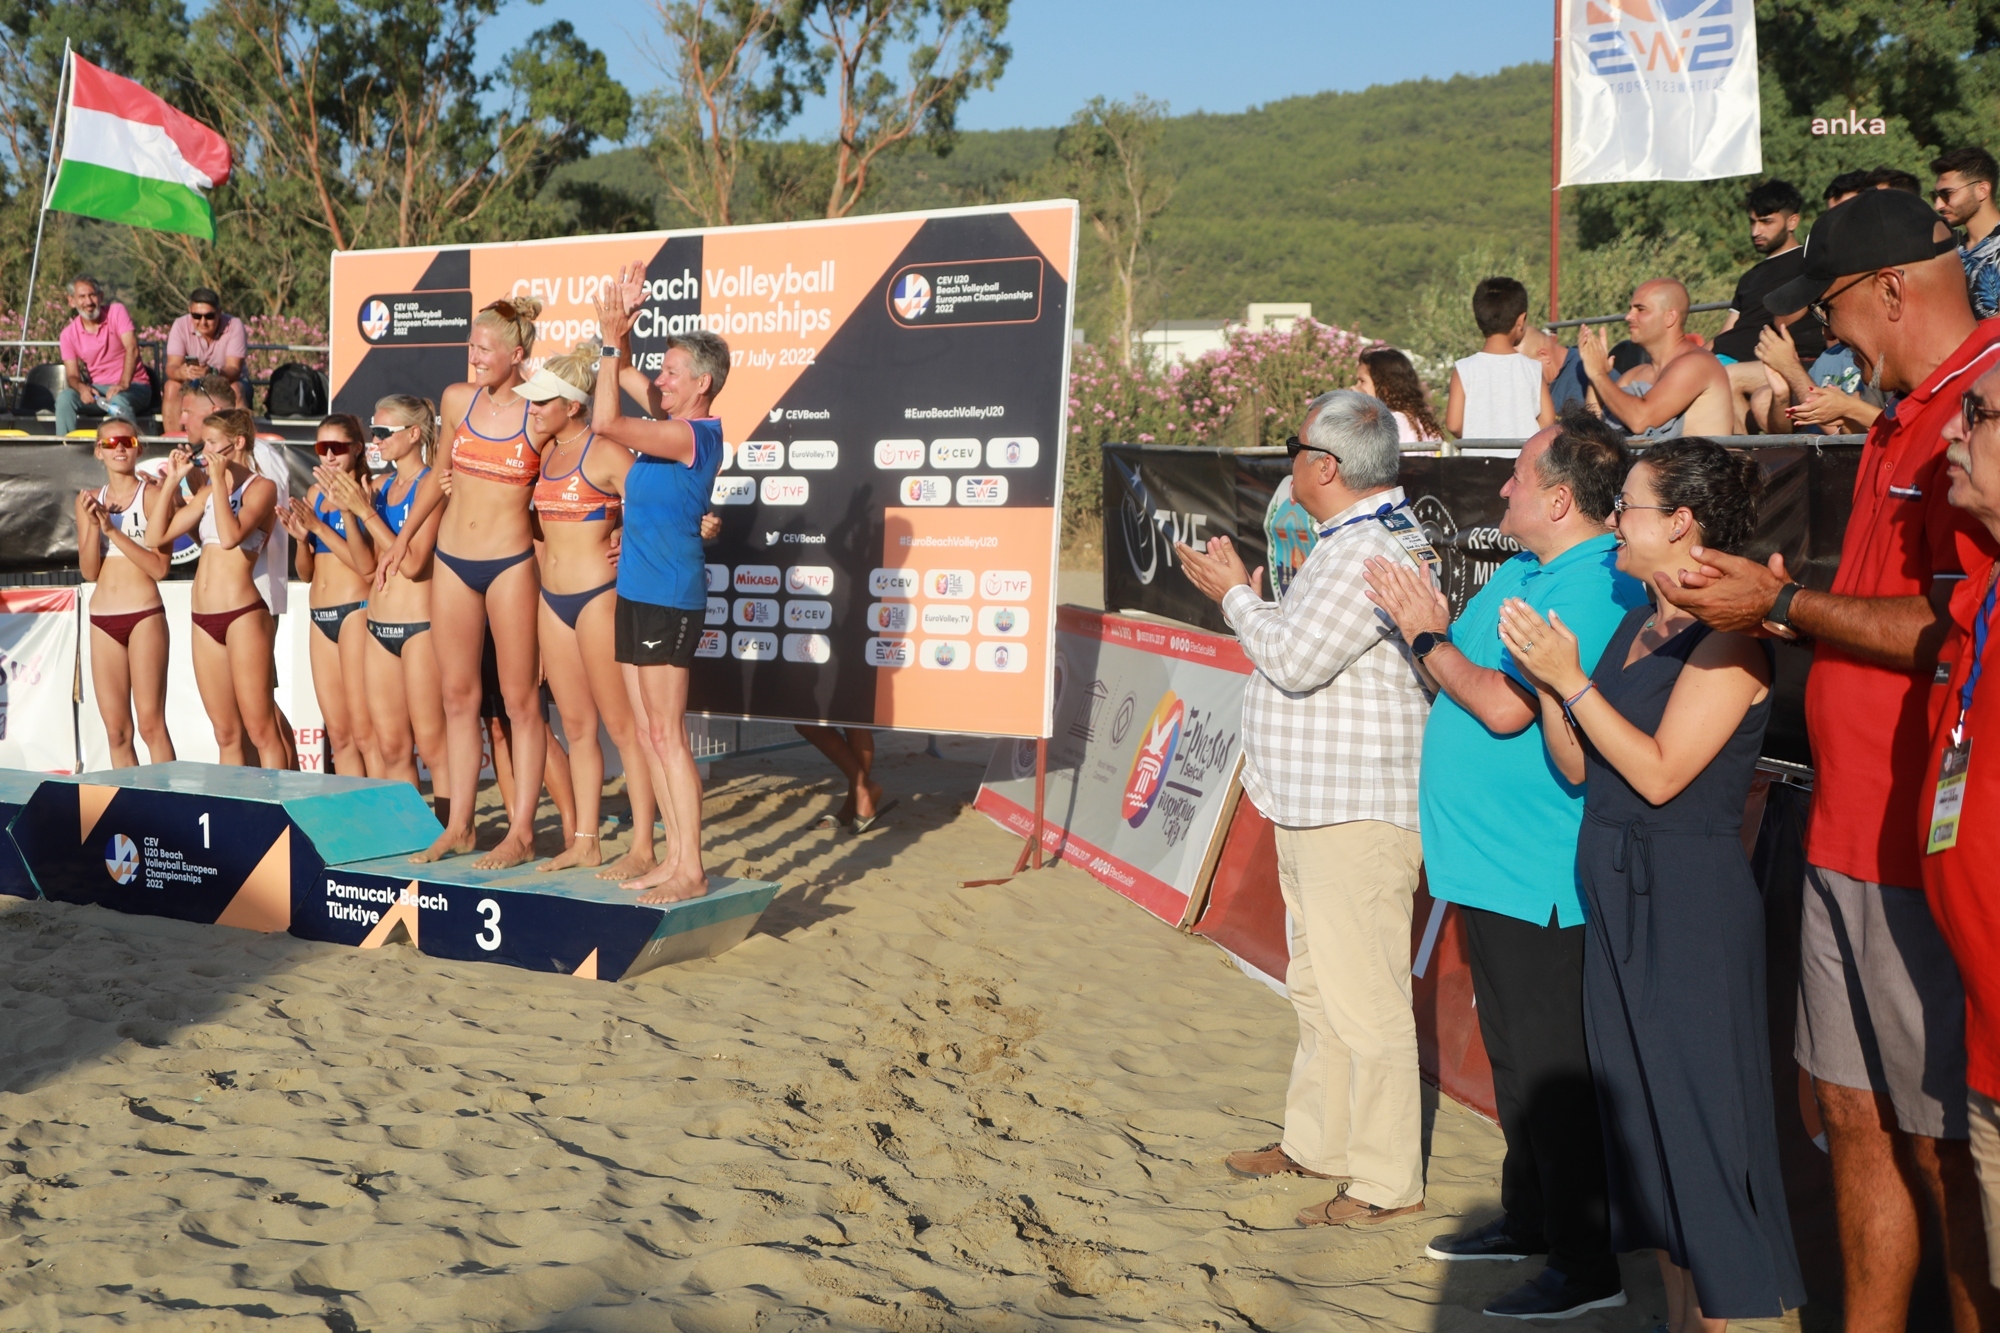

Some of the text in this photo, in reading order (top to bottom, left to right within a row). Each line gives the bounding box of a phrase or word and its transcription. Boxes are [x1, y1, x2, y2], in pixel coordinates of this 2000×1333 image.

[512, 276, 561, 305] CEV
[624, 268, 698, 301] each
[705, 260, 835, 303] Volleyball
[937, 275, 969, 285] CEV U20
[936, 282, 999, 294] Beach Volleyball
[936, 290, 1033, 304] European Championships
[394, 302, 419, 311] CEV U20
[935, 304, 954, 313] 2022
[394, 310, 442, 320] Beach Volleyball
[633, 300, 831, 339] Championships
[394, 318, 467, 329] European Championships
[393, 328, 408, 336] 2022
[747, 348, 776, 371] July
[779, 347, 815, 365] 2022
[785, 409, 830, 420] CEVBeach
[904, 406, 1004, 419] #EuroBeachVolleyU20
[515, 443, 523, 458] 1
[791, 450, 835, 460] EuroVolley.TV
[898, 450, 920, 461] TVF
[952, 449, 974, 458] CEV
[506, 458, 525, 469] NED
[567, 476, 579, 491] 2
[562, 492, 579, 501] NED
[729, 486, 750, 496] CEV
[783, 486, 804, 497] TVF
[783, 533, 826, 544] CEVBeach
[899, 536, 998, 549] #EuroBeachVolleyU20
[808, 576, 829, 586] TVF
[890, 578, 912, 588] CEV
[1004, 581, 1027, 592] TVF
[804, 610, 825, 619] CEV
[925, 614, 970, 624] EuroVolley.TV
[751, 641, 772, 651] CEV
[199, 812, 210, 849] 1
[144, 837, 159, 847] CEV
[144, 847, 183, 860] U20 Beach
[145, 858, 218, 875] Volleyball European
[145, 868, 202, 885] Championships
[146, 879, 164, 889] 2022
[327, 879, 448, 911] Pamucak Beach
[326, 901, 380, 927] Türkiye
[475, 898, 501, 951] 3
